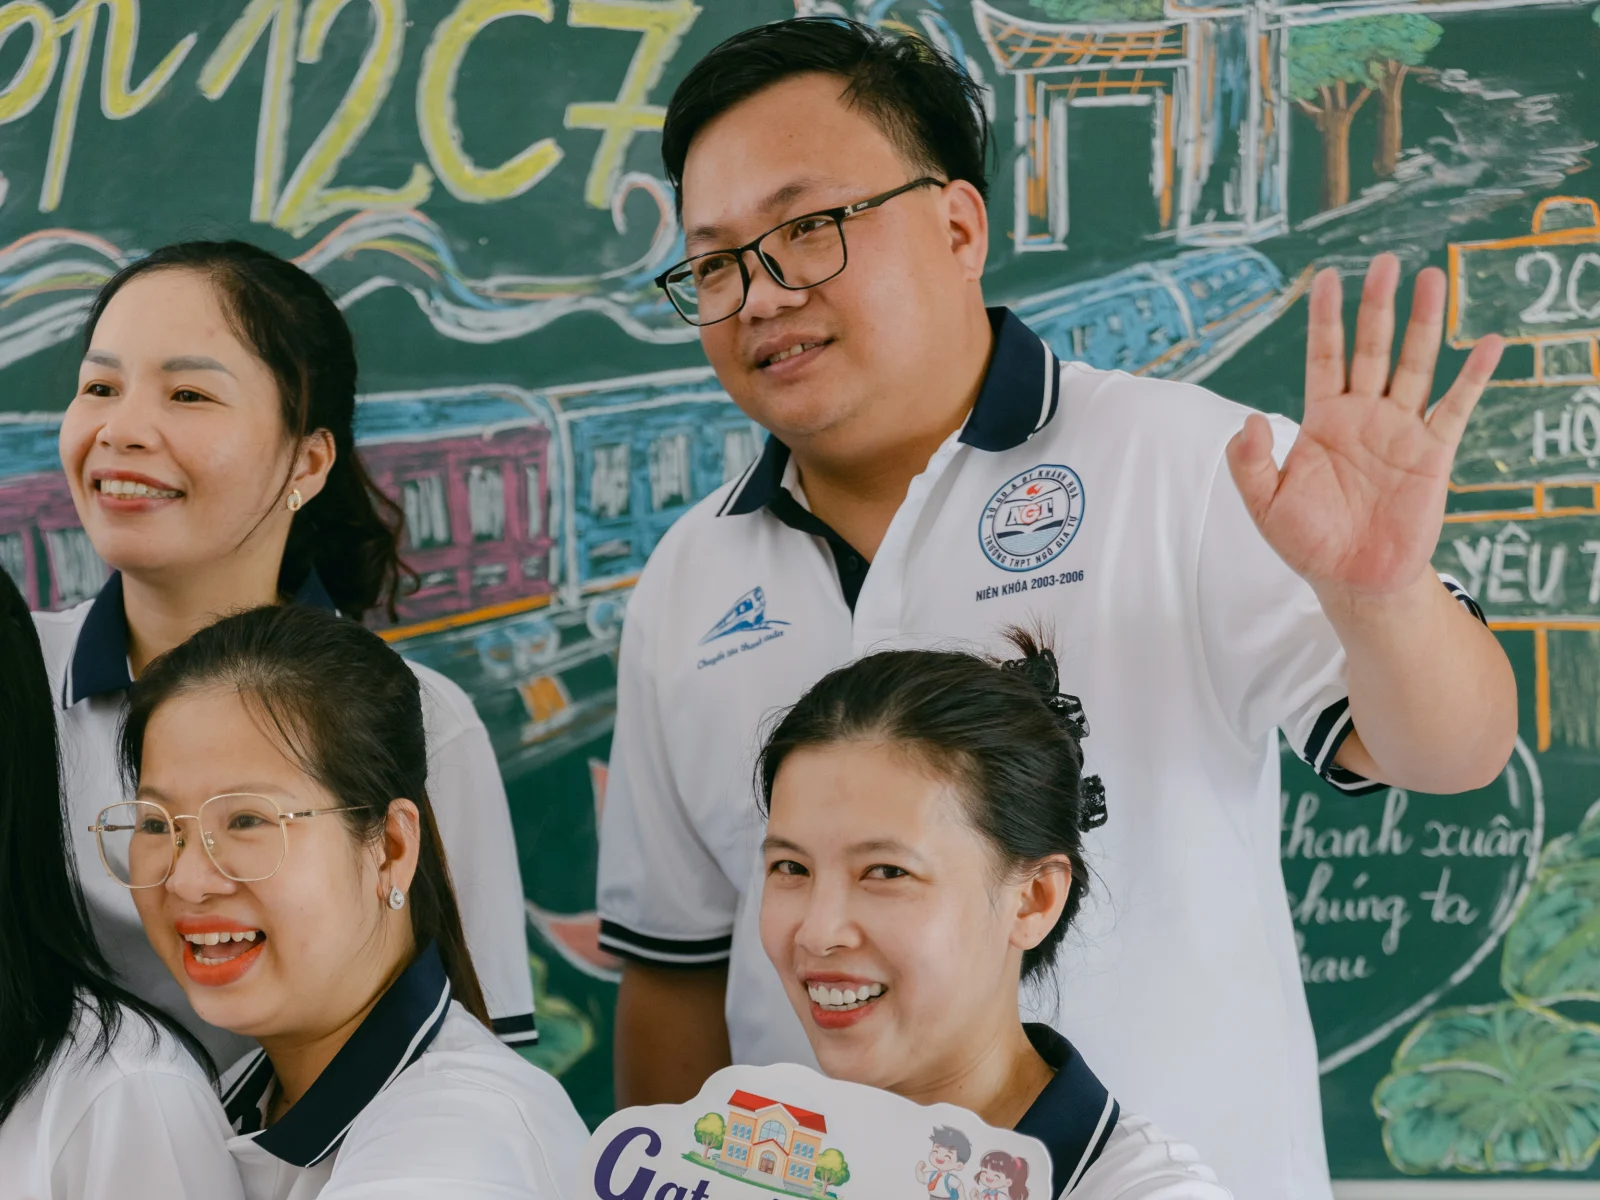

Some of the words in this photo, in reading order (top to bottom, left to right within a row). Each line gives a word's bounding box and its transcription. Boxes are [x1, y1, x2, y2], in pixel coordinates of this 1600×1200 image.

[1009, 557, 1032, 568] THPT
[1055, 532, 1070, 549] GIA
[1453, 520, 1566, 604] YÊU
[975, 585, 999, 602] NIÊN
[1001, 578, 1028, 596] KHÓA
[1031, 569, 1085, 590] 2003-2006
[1421, 815, 1530, 858] xuân
[1420, 867, 1478, 925] ta
